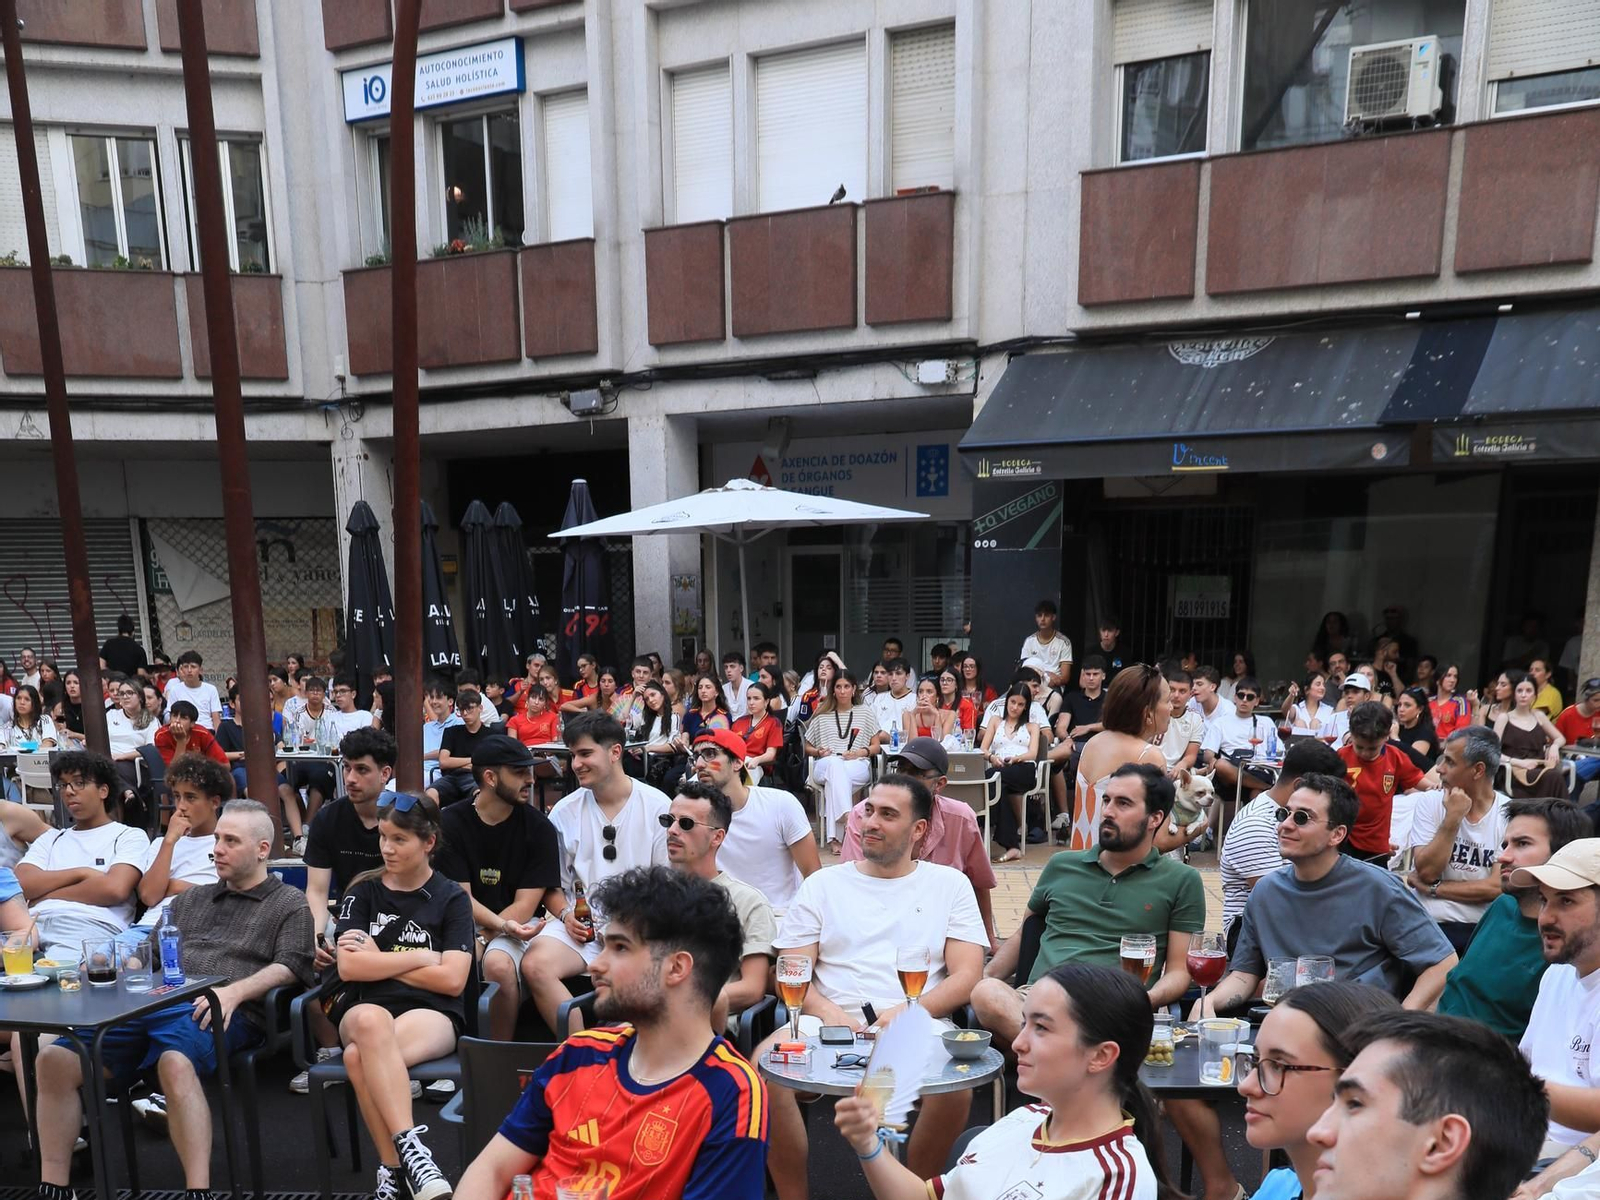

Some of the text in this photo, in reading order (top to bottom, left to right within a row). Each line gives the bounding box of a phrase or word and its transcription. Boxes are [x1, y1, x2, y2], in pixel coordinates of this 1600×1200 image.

[419, 50, 504, 75] AUTOCONOCIMIENTO
[425, 68, 499, 90] SALUD HOLÍSTICA
[781, 449, 898, 469] AXENCIA DE DOAZÓN
[1001, 459, 1031, 468] BODEGA
[781, 468, 852, 484] DE ÓRGANOS
[998, 484, 1056, 521] VEGANO
